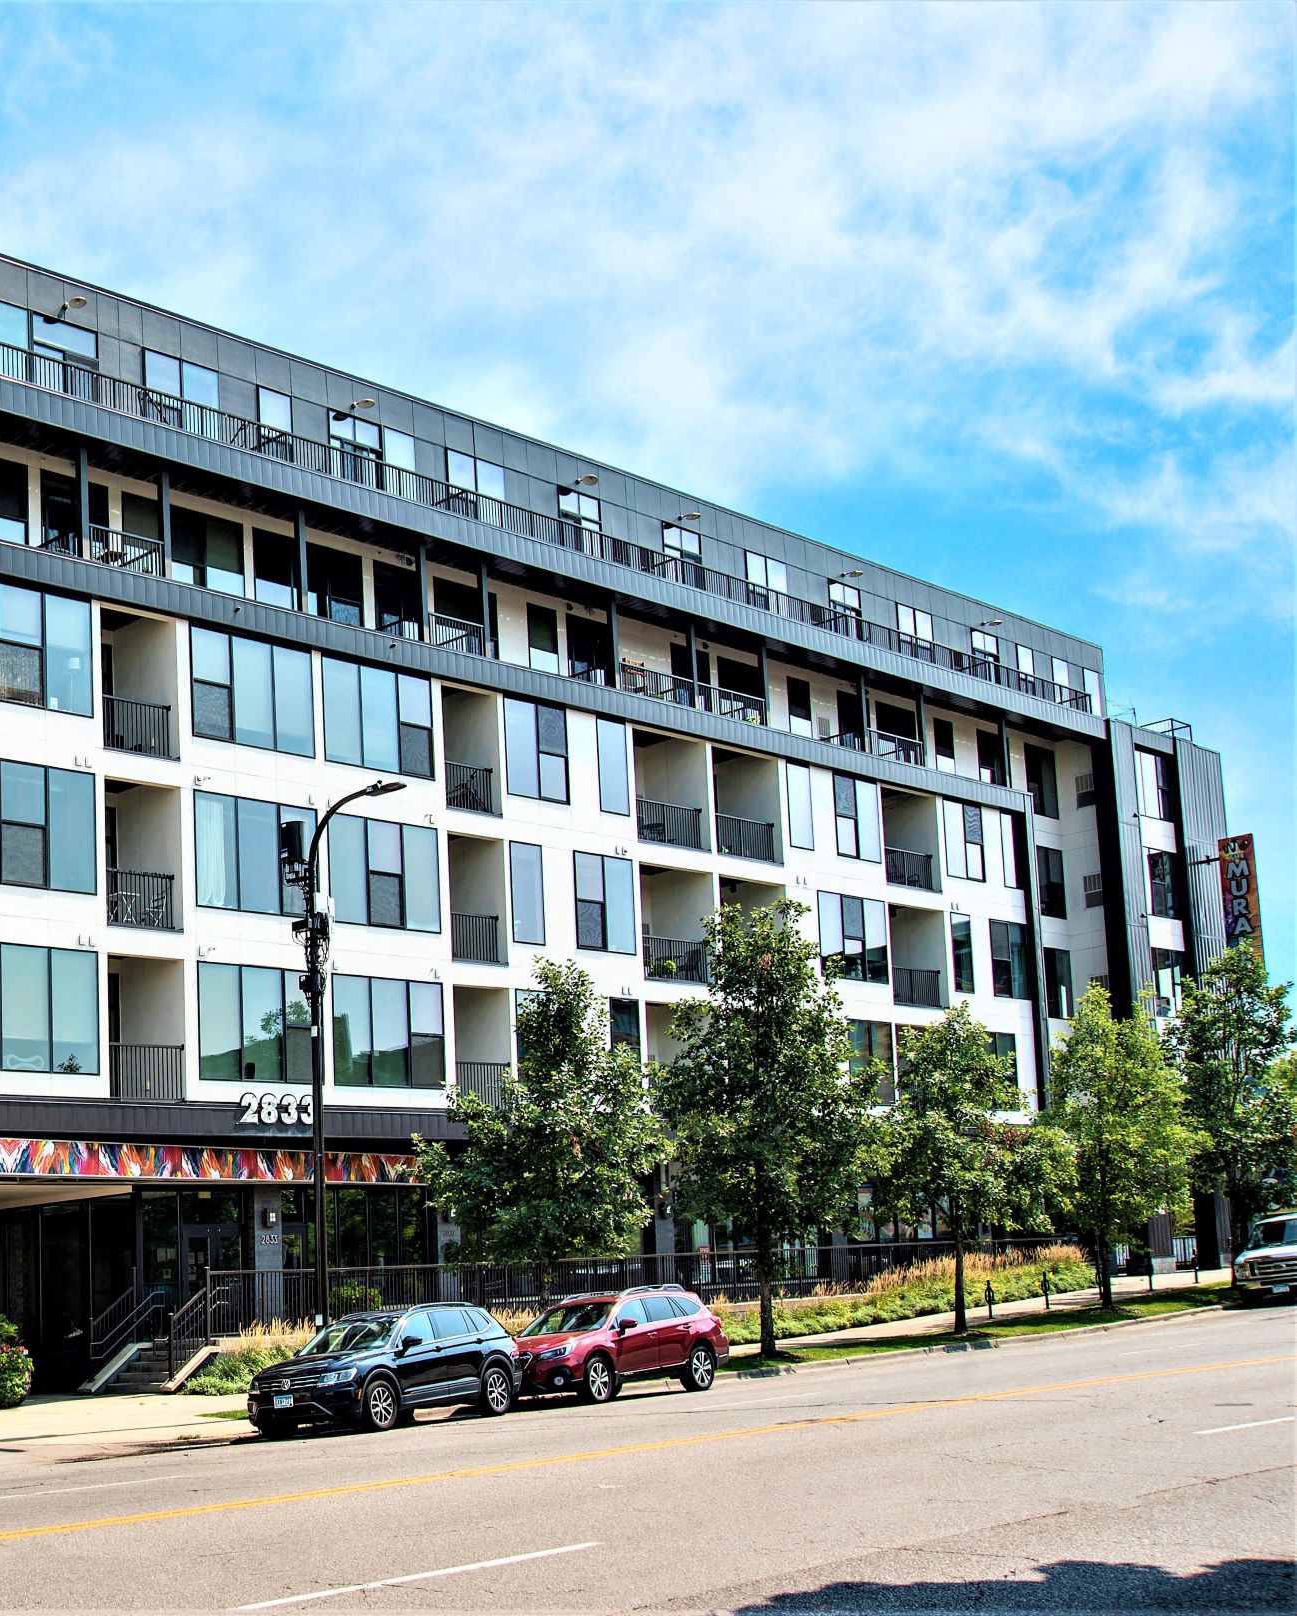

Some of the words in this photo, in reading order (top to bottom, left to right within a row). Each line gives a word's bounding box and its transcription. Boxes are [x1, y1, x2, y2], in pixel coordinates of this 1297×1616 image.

[1226, 859, 1253, 944] MURA
[236, 1092, 314, 1125] 2833
[261, 1235, 278, 1244] 2833
